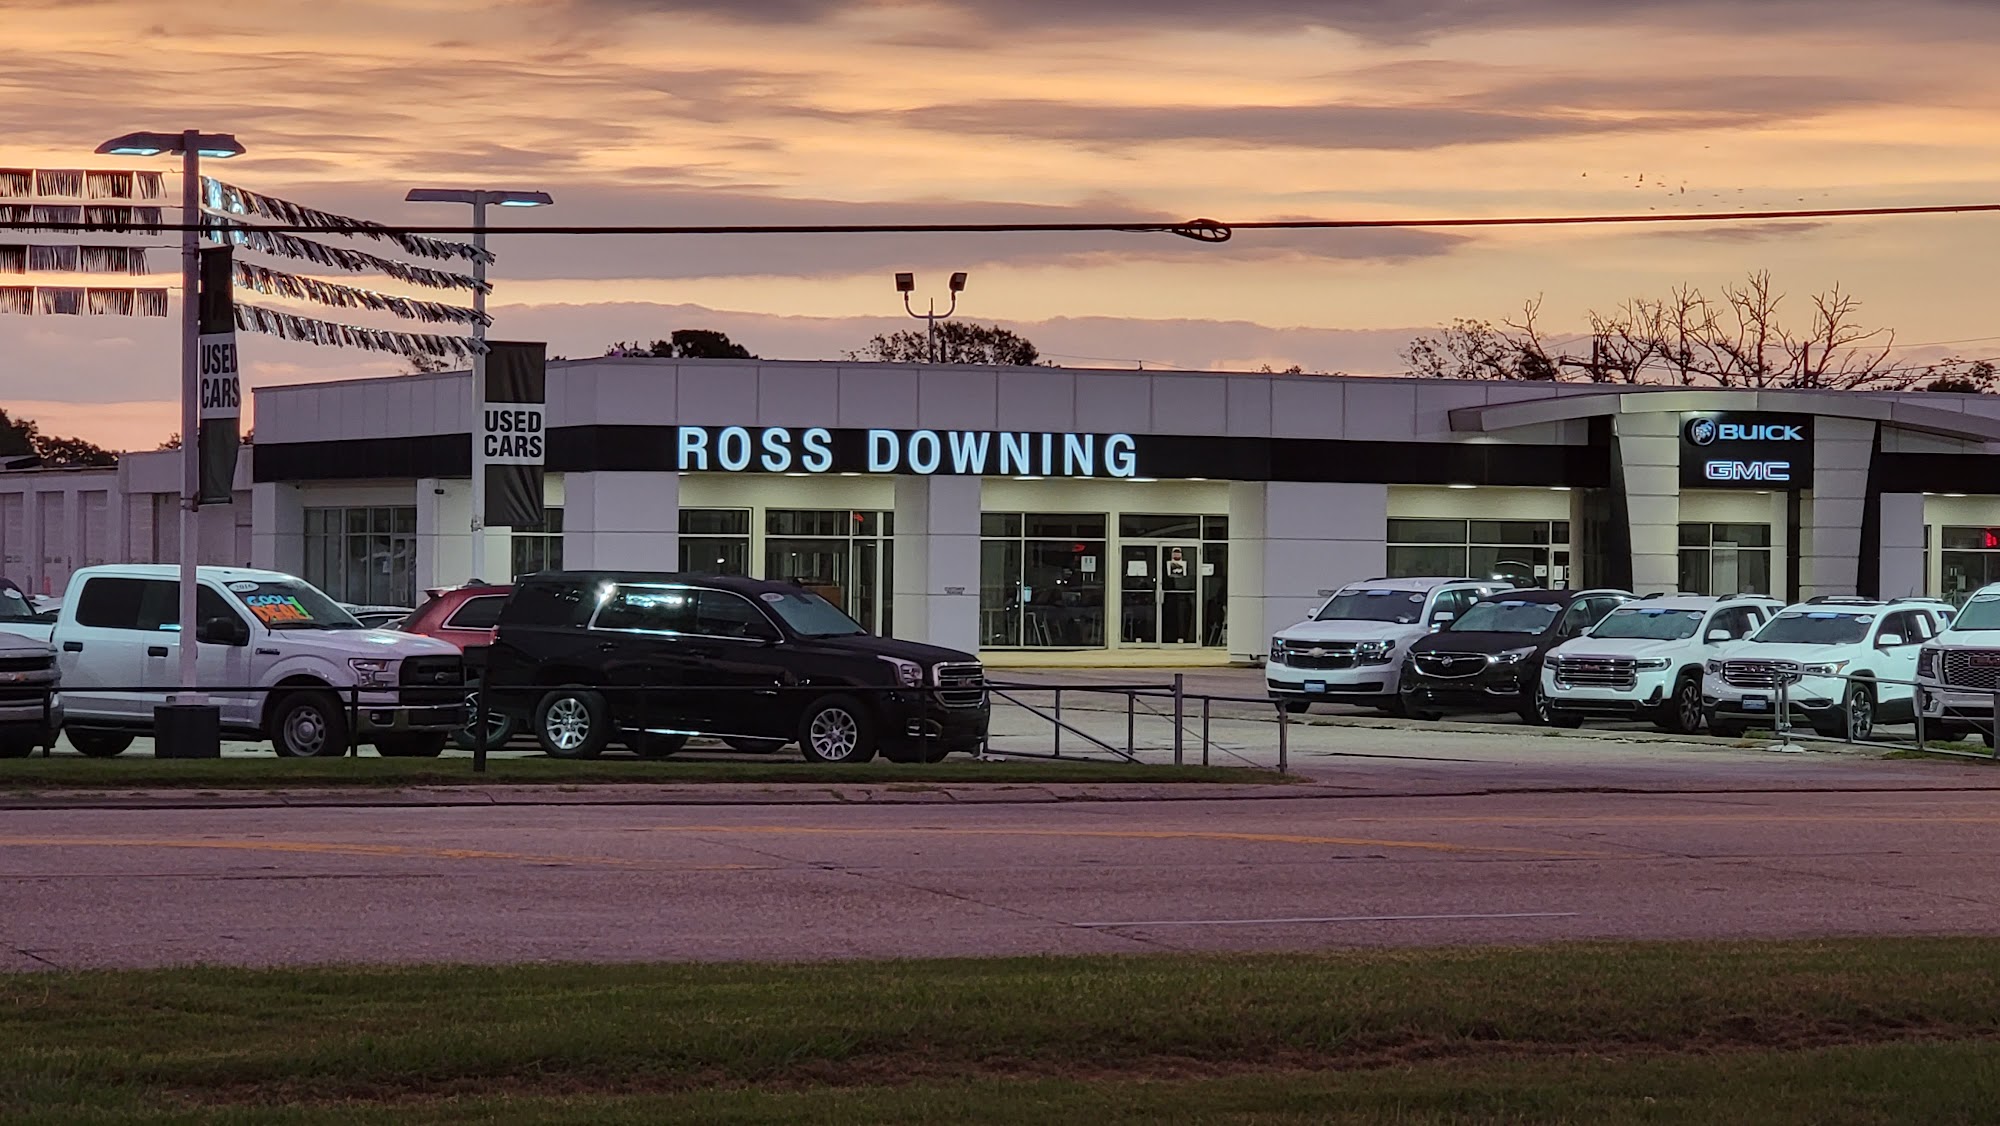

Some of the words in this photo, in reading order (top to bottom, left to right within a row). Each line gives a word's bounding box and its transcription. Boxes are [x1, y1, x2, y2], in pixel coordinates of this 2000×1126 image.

[202, 343, 238, 374] USED
[201, 377, 241, 409] CARS
[484, 410, 542, 433] USED
[1718, 423, 1805, 441] BUICK
[484, 434, 543, 458] CARS
[677, 425, 834, 473] ROSS
[867, 429, 1137, 478] DOWNING
[1705, 461, 1791, 481] GMC
